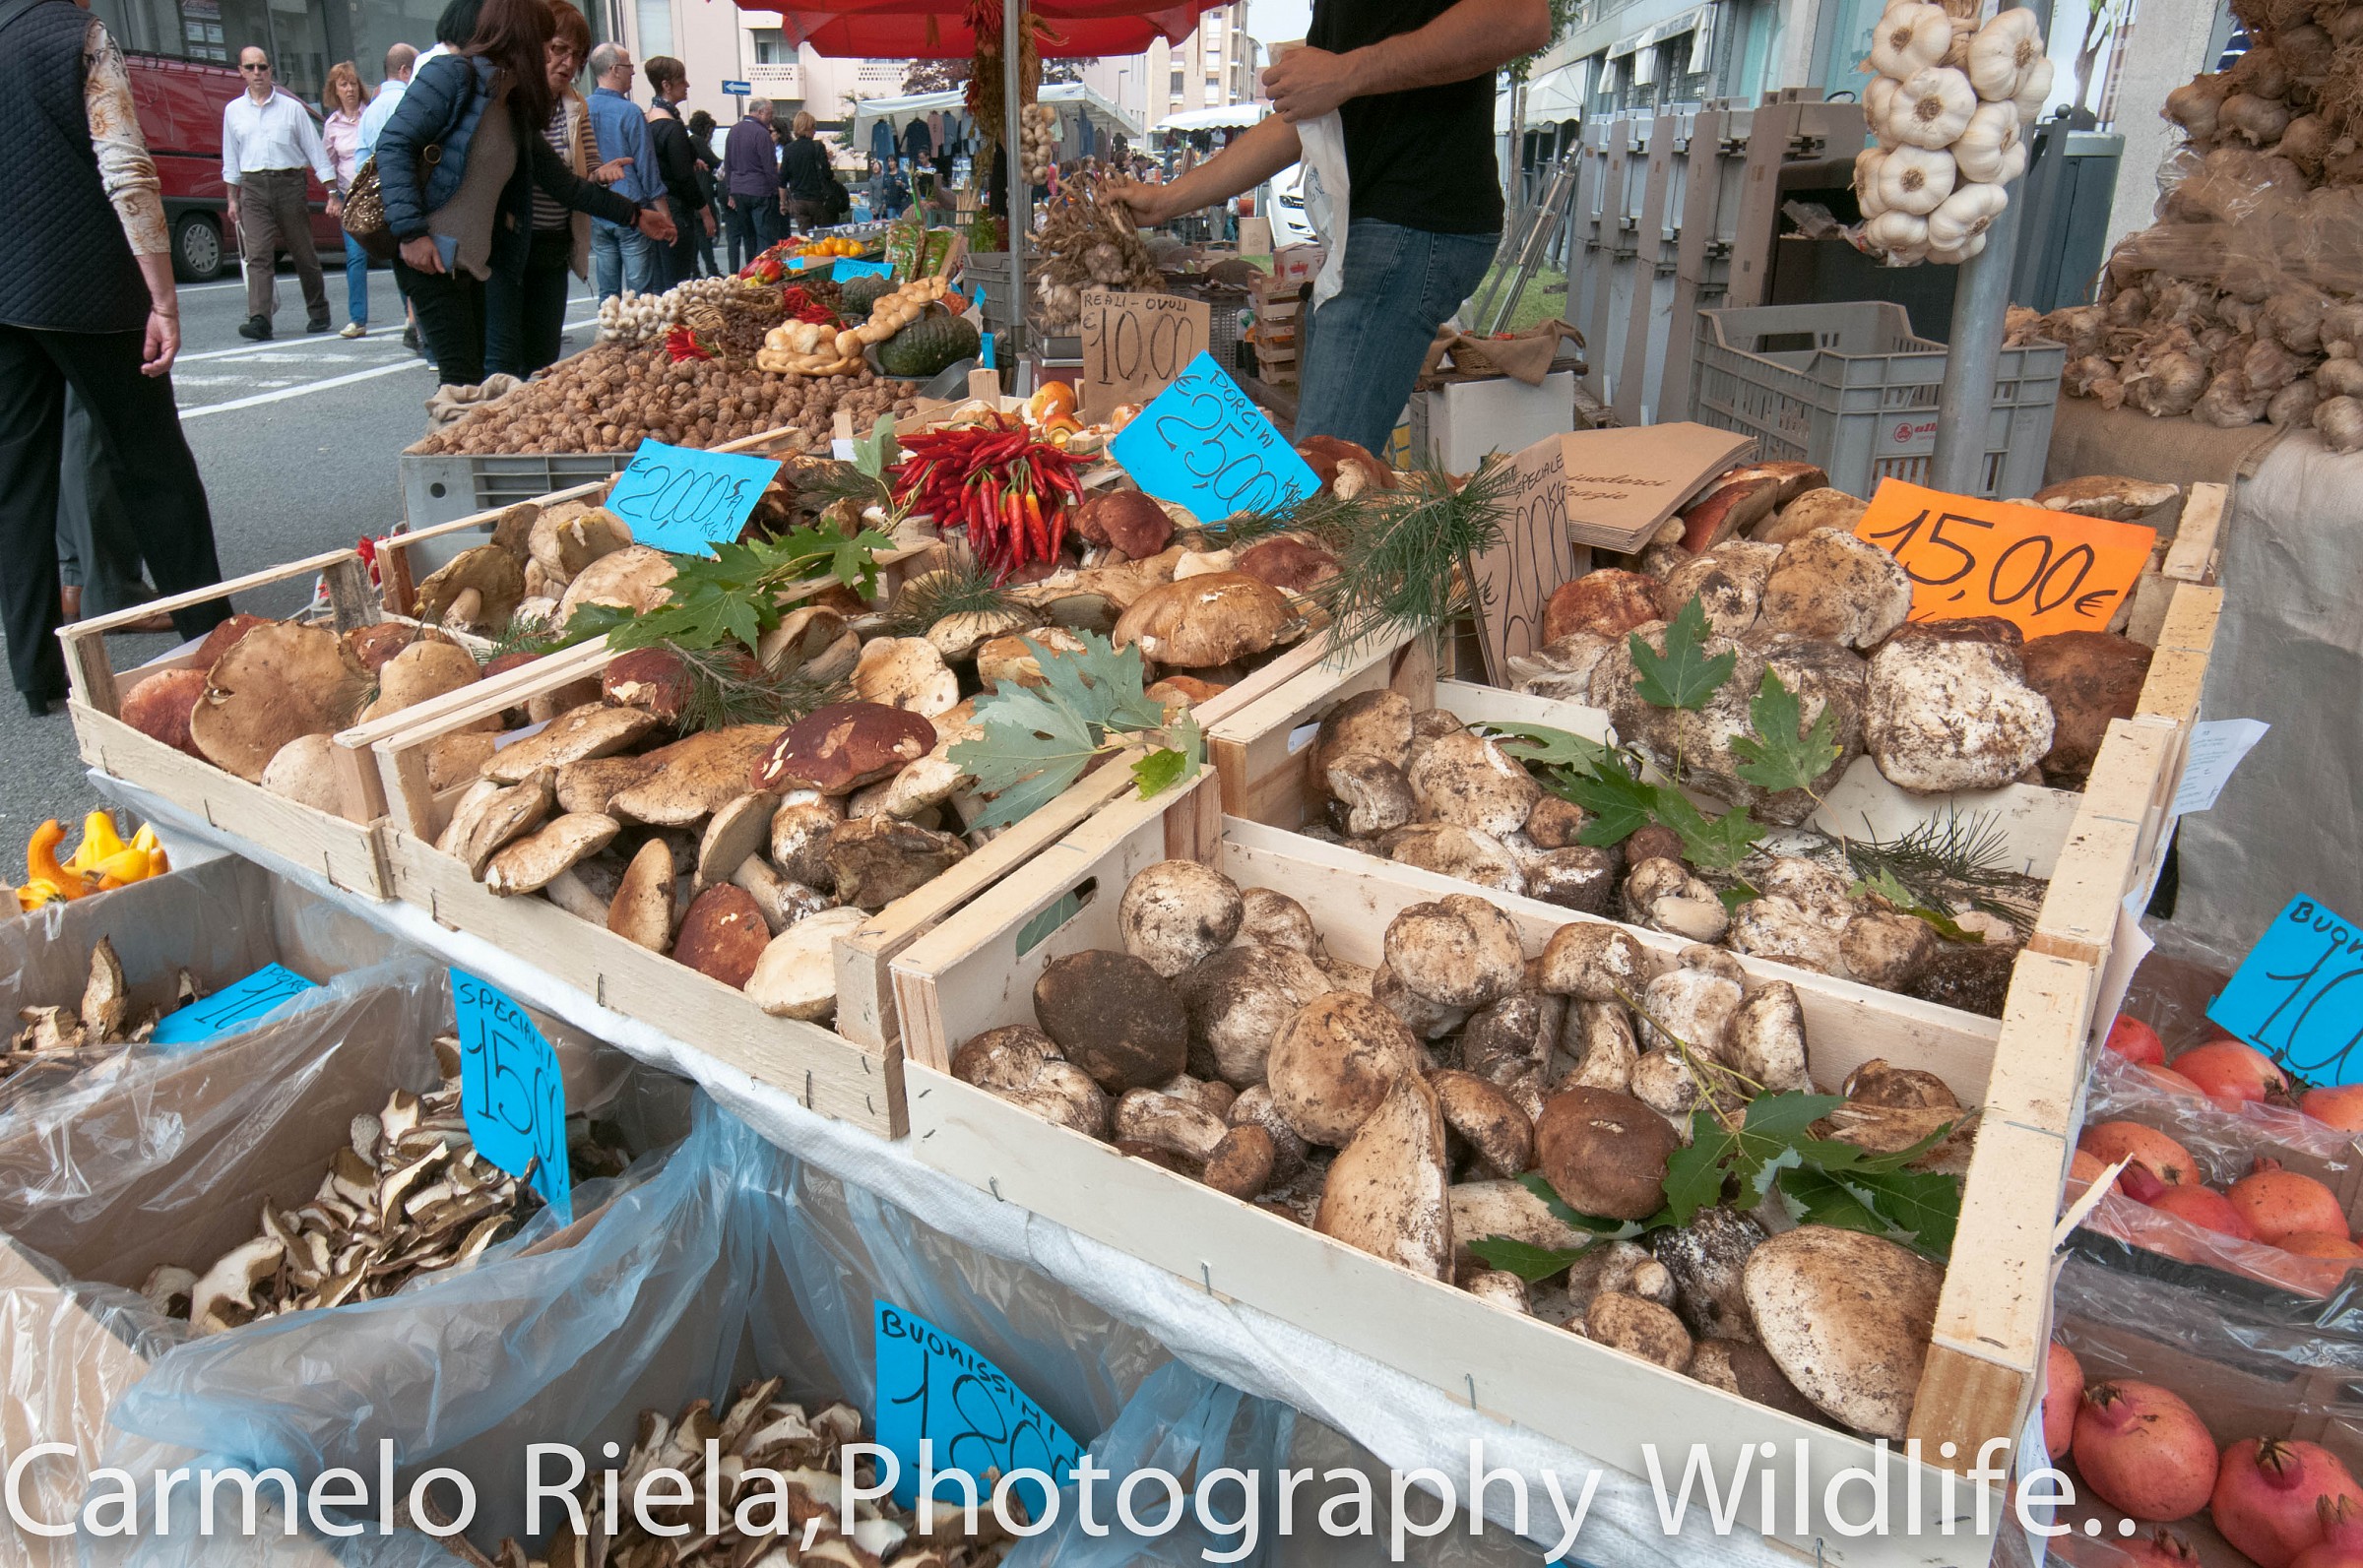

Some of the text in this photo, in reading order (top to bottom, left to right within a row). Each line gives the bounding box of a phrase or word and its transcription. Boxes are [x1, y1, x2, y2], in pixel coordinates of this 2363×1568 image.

[1084, 293, 1126, 309] REALI
[1145, 297, 1187, 313] OVULI
[700, 516, 719, 540] KG
